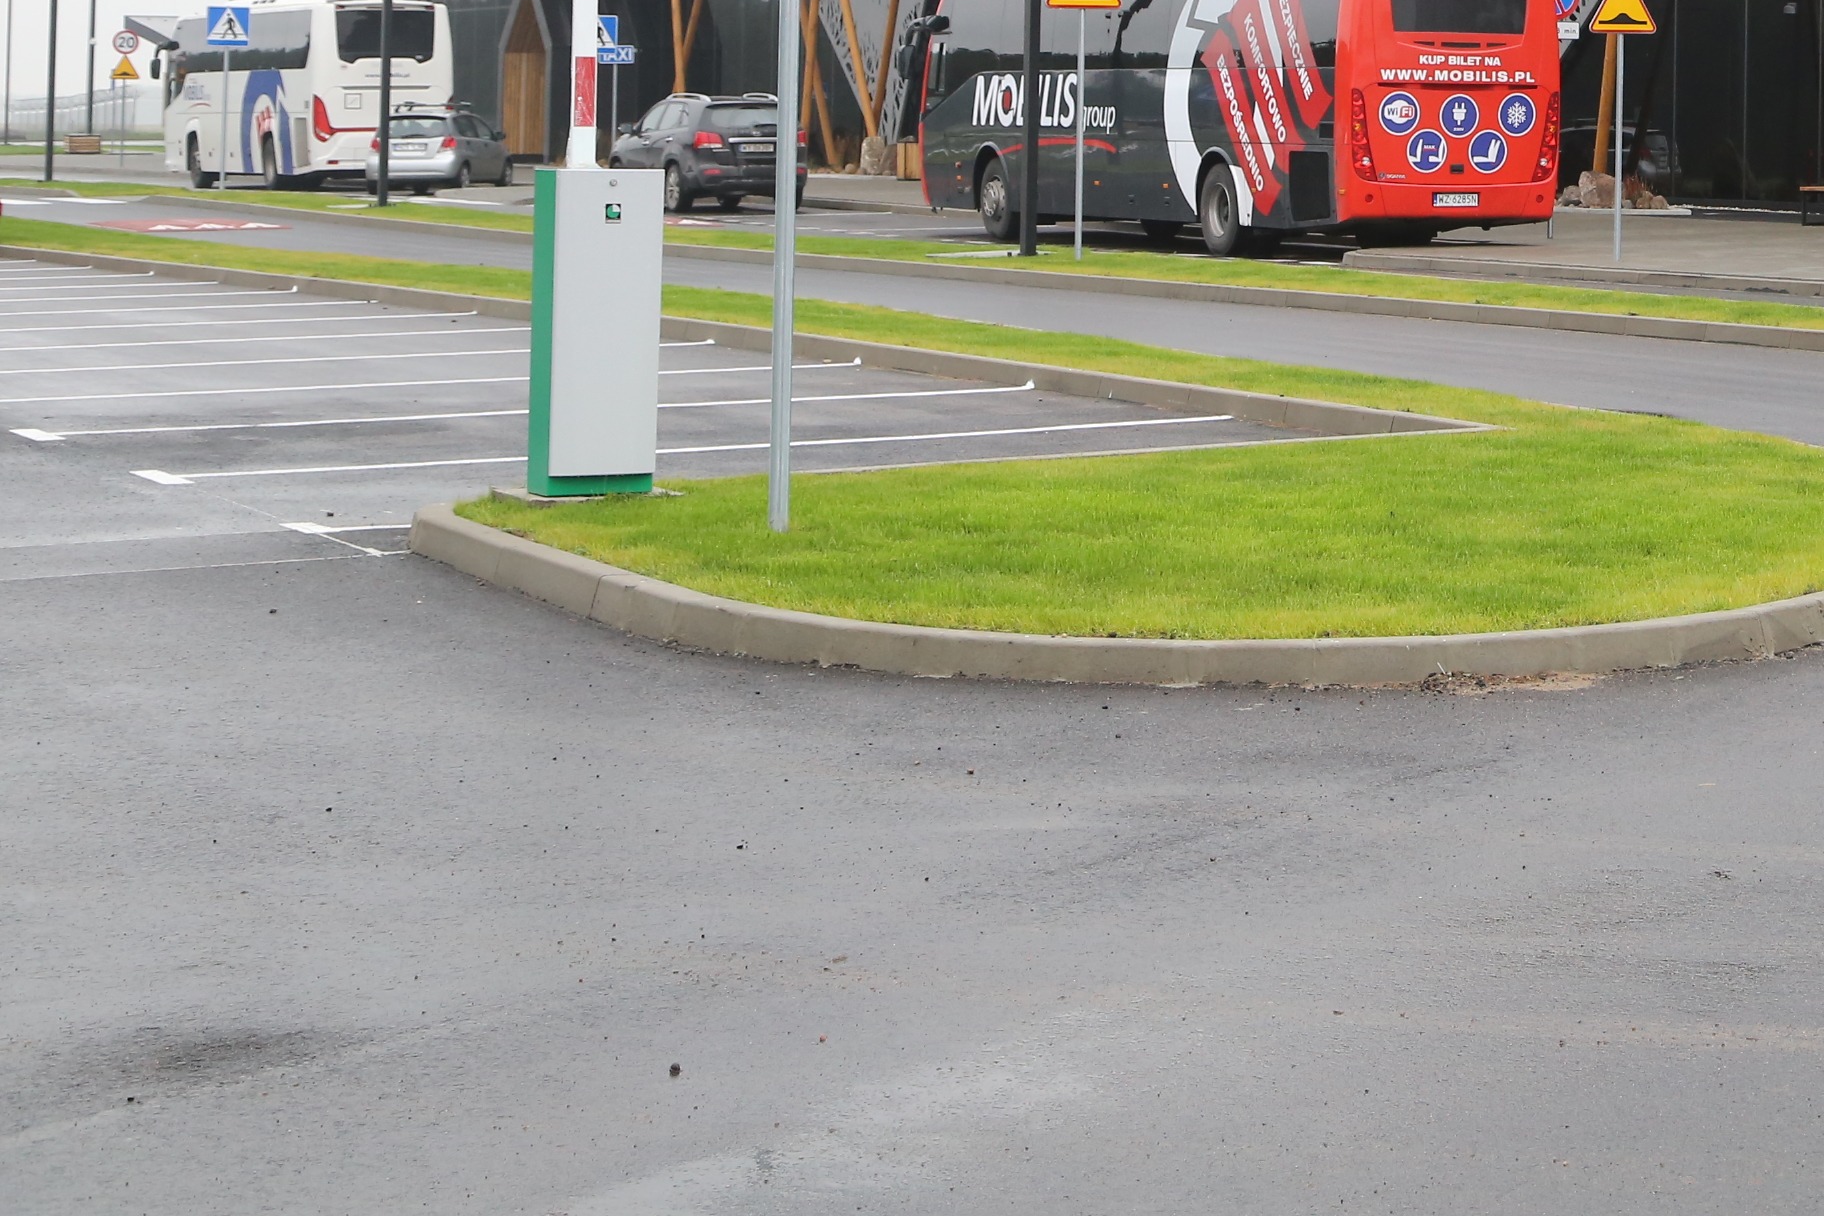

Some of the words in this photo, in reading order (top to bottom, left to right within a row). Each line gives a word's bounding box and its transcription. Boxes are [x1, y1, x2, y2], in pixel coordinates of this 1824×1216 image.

[117, 36, 135, 49] 20
[1419, 55, 1446, 65] KUP
[1448, 55, 1482, 66] BILET
[1484, 56, 1501, 66] NA
[1243, 12, 1286, 143] KOMFORTOWO
[1380, 68, 1535, 83] WWW.MOBILIS.PL
[1216, 53, 1264, 192] BEZPOŚREDNIO
[1453, 195, 1477, 204] 6285N
